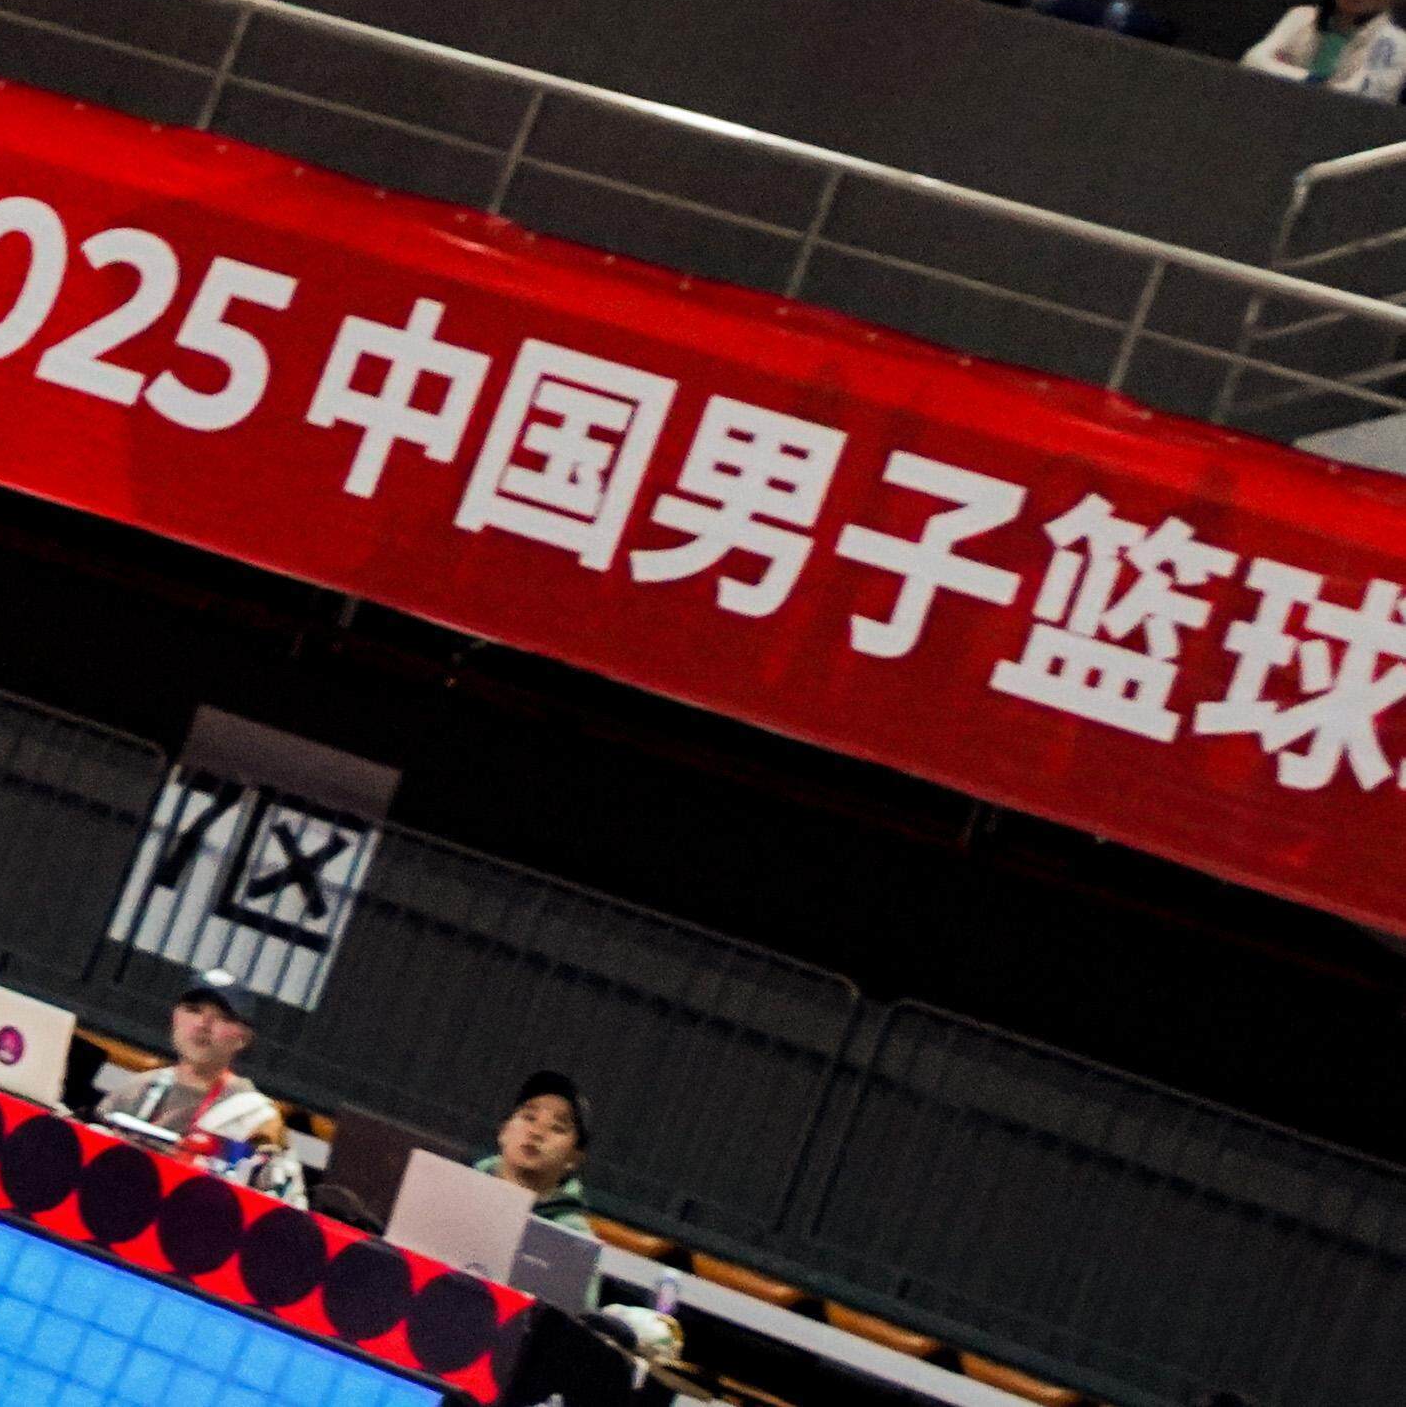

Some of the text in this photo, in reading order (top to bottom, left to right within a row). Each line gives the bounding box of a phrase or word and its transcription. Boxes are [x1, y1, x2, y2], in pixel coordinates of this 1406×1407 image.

[305, 294, 1406, 792] 中国男子篮球
[153, 772, 375, 952] 7区
